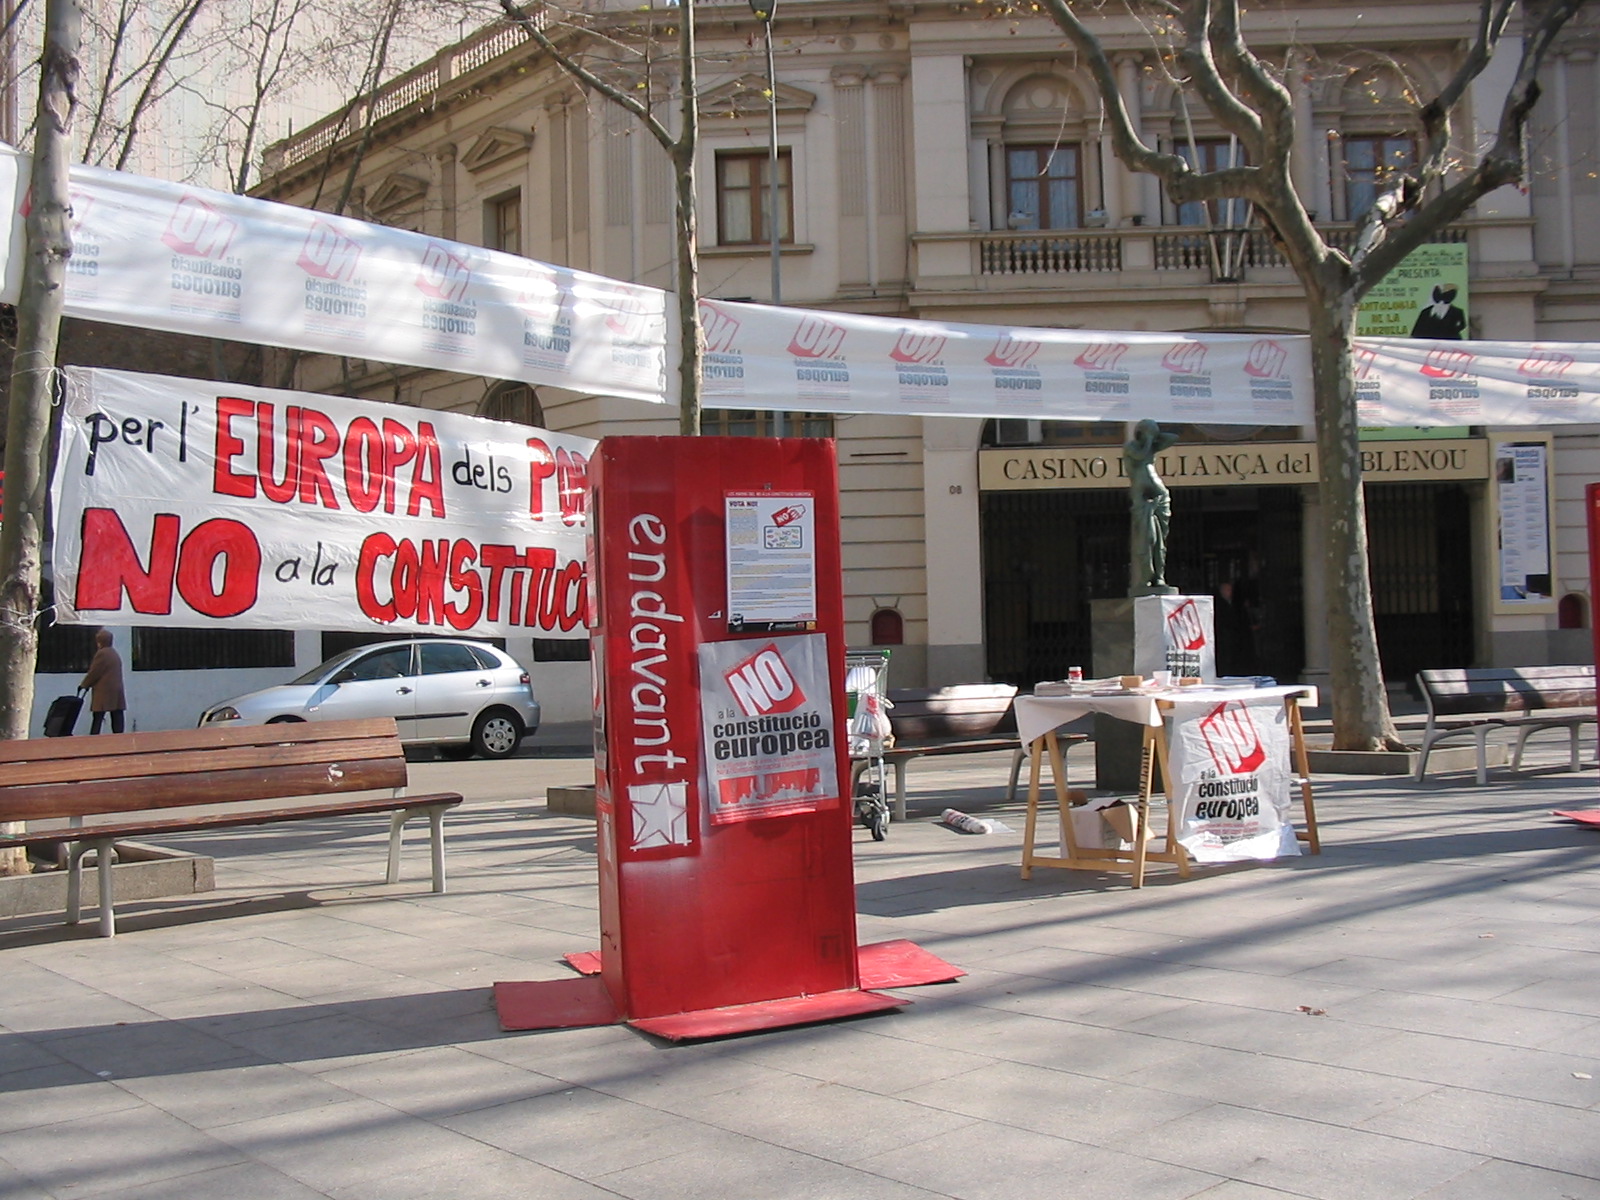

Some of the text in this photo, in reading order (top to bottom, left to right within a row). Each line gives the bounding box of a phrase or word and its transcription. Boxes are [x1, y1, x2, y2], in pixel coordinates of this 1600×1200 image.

[85, 412, 164, 476] per
[213, 396, 446, 519] EUROPA
[452, 443, 513, 493] dels
[1002, 456, 1108, 481] CASINO
[1276, 452, 1312, 474] del
[1360, 448, 1468, 472] BLENOU
[776, 512, 789, 523] NO
[74, 507, 262, 618] NO
[275, 556, 301, 583] a
[311, 541, 338, 586] la
[1168, 603, 1202, 650] NO
[627, 512, 689, 776] endavant
[728, 650, 794, 717] NO
[713, 711, 821, 739] constitució
[718, 707, 736, 719] a la
[714, 728, 830, 760] europea
[1203, 701, 1258, 775] NO
[1198, 774, 1258, 798] constitució
[1195, 795, 1260, 821] europea
